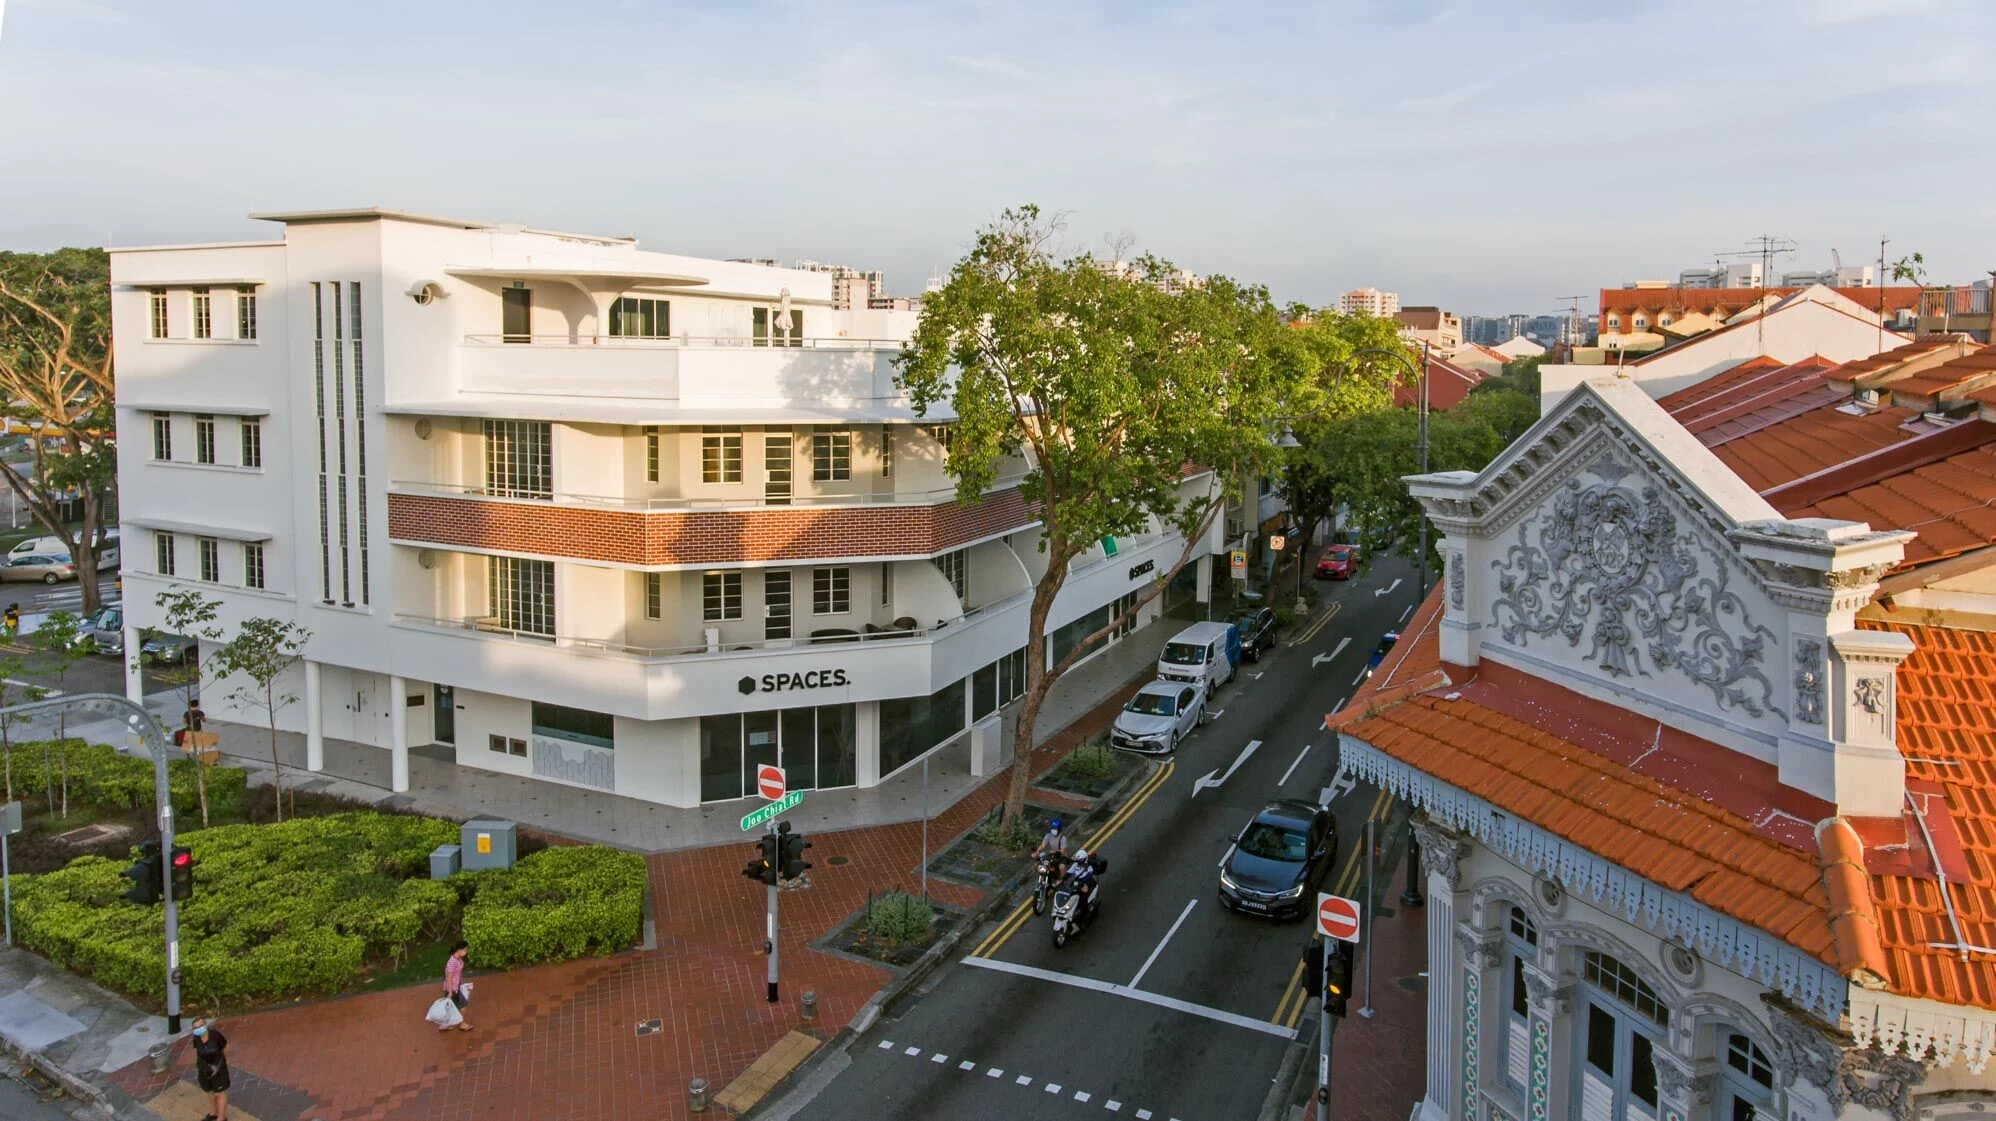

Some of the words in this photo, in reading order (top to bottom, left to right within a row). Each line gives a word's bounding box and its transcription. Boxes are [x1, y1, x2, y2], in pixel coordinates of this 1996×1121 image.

[761, 668, 851, 693] SPACES.
[747, 815, 762, 829] Joo
[764, 801, 787, 818] Chiat
[789, 792, 800, 806] Rd
